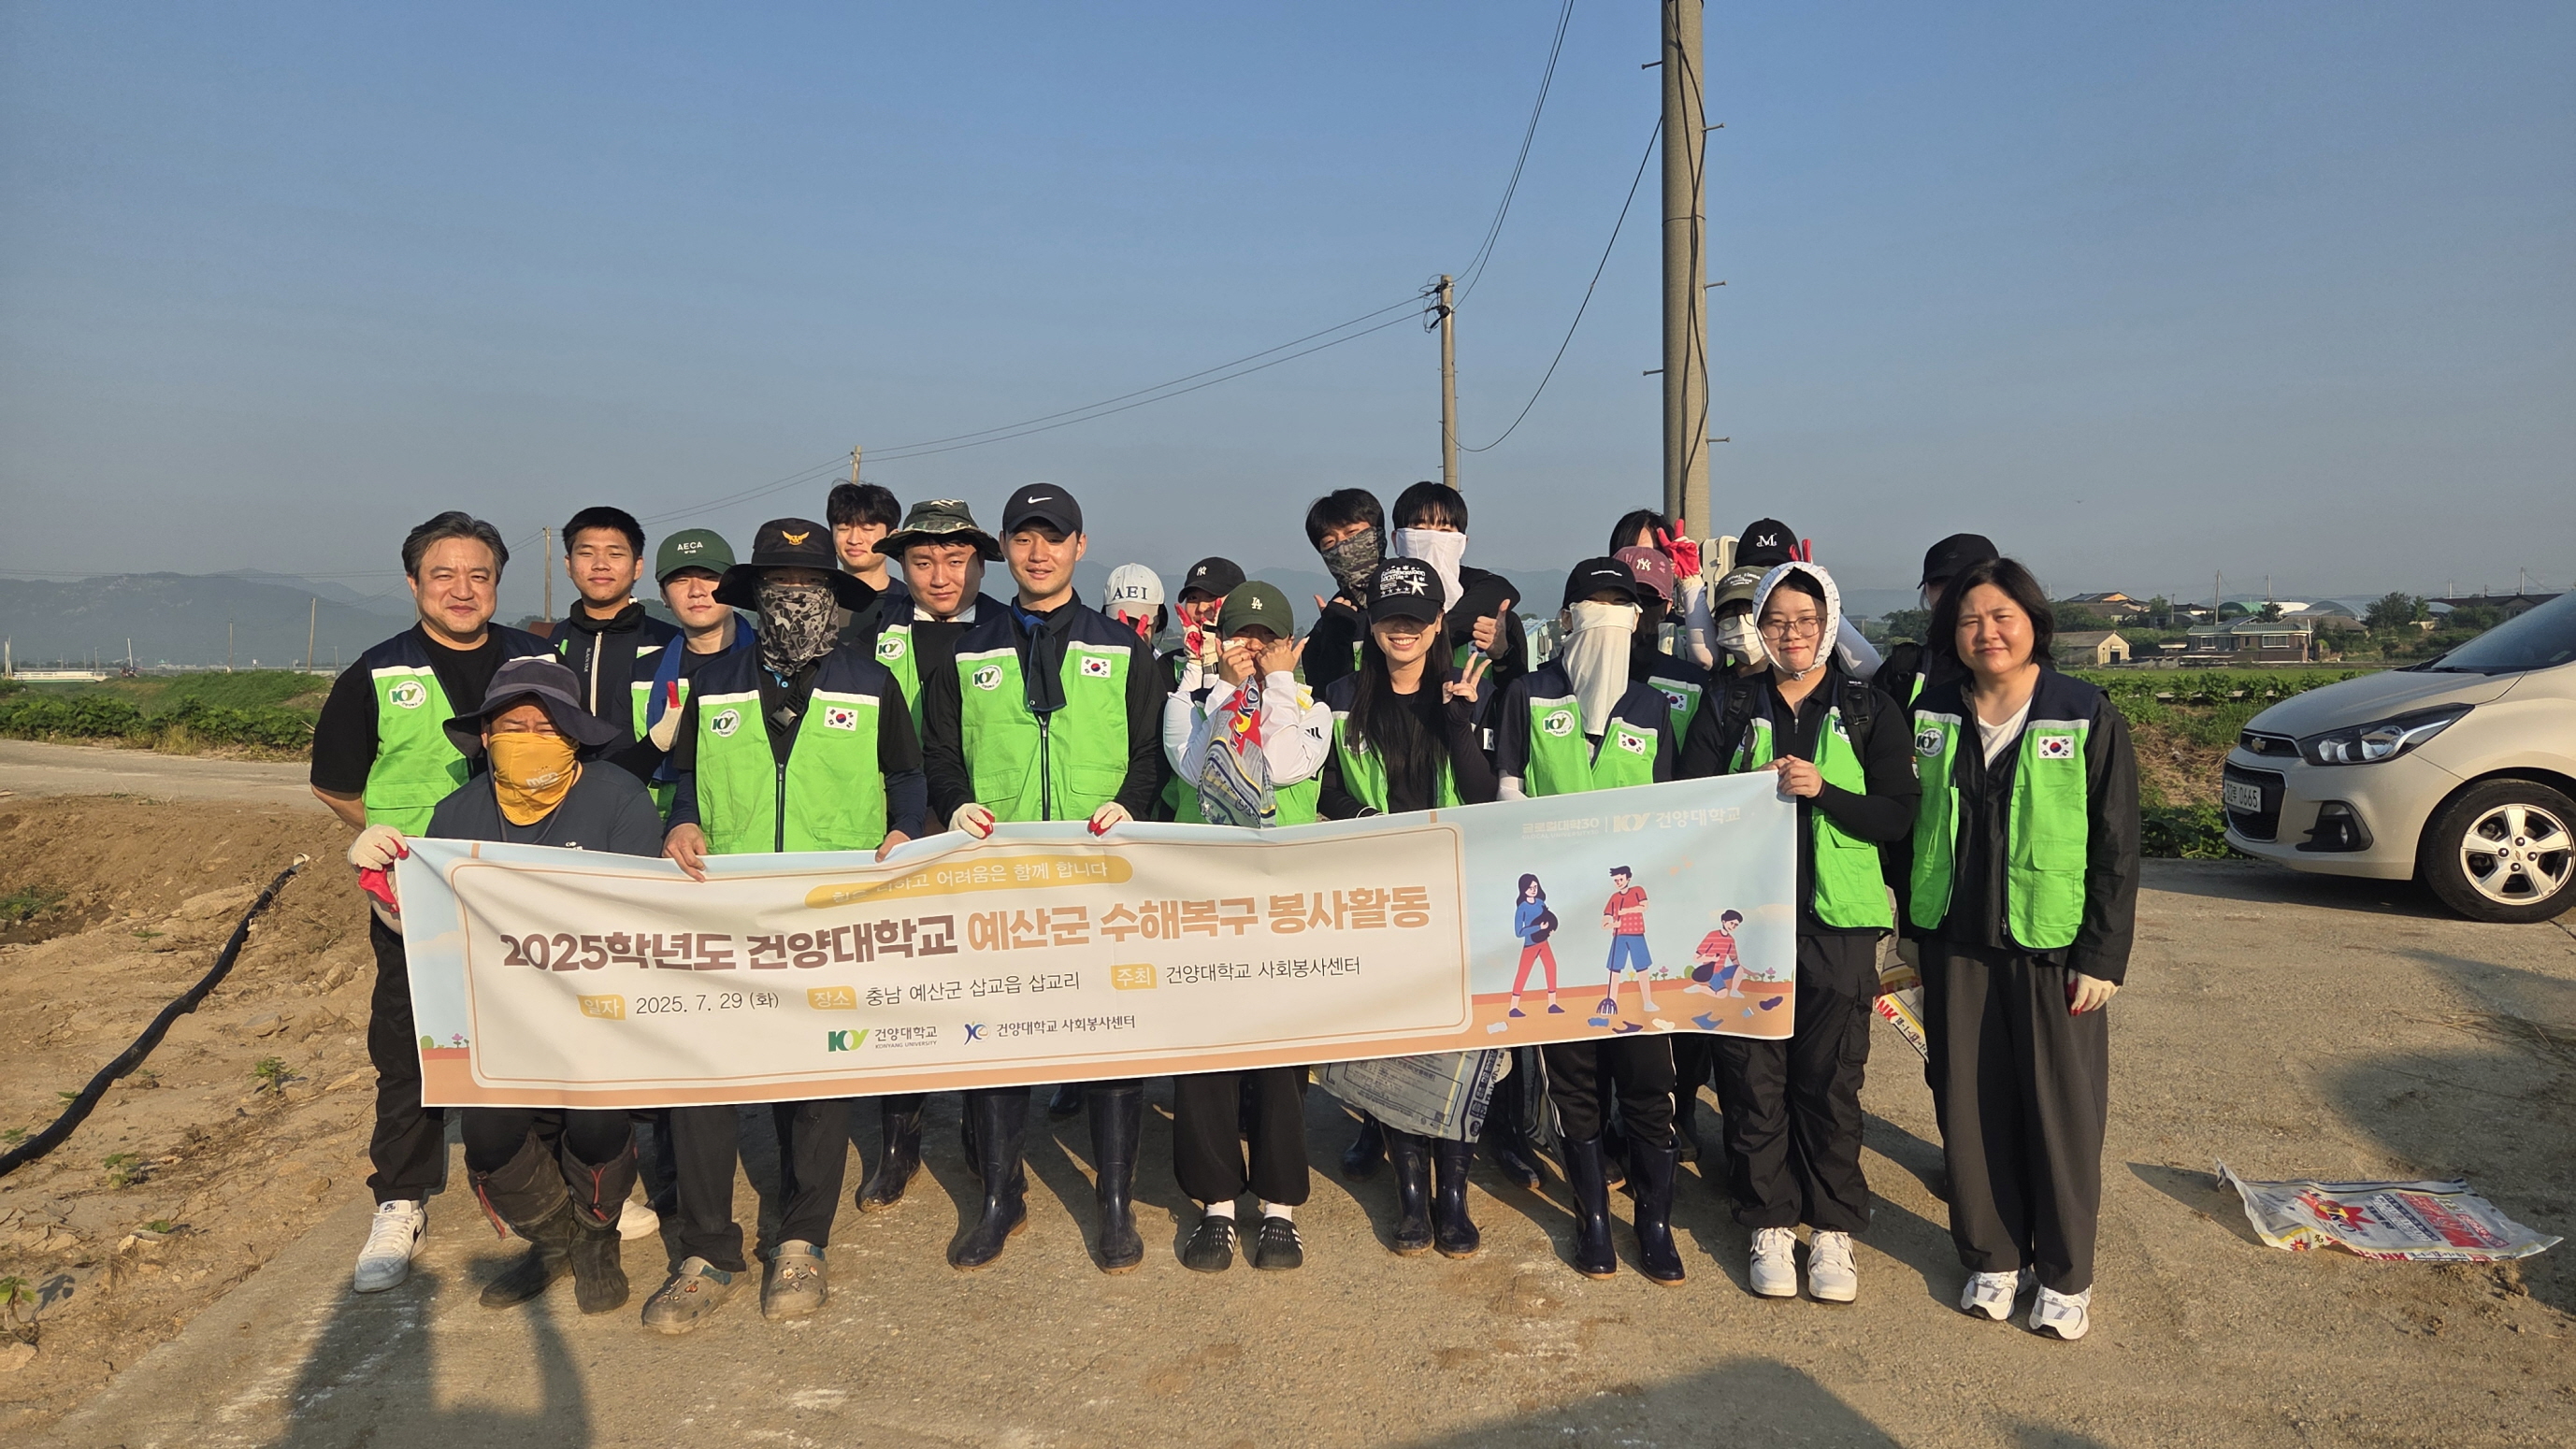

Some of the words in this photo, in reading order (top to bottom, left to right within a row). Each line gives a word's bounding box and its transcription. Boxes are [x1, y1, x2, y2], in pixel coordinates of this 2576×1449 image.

[677, 541, 703, 552] AECA
[1636, 557, 1652, 572] NY
[1112, 586, 1148, 600] AEI
[1251, 596, 1263, 610] LA
[2239, 786, 2258, 808] 0665
[1655, 807, 1741, 829] 건양대학교
[936, 864, 1007, 887] 어려움은
[1013, 862, 1049, 882] 함께
[1056, 860, 1108, 880] 합니다
[500, 930, 737, 971] 2025학년도
[747, 914, 958, 970] 건양대학교
[968, 904, 1090, 952] 예산군
[1101, 897, 1259, 942] 수해복구
[1268, 885, 1431, 934] 봉사활동
[1115, 967, 1151, 987] 주최
[1165, 963, 1252, 985] 건양대학교
[1258, 955, 1361, 979] 사회봉사센터
[865, 986, 900, 1006] 충남
[909, 981, 962, 1003] 예산군
[970, 974, 1022, 997] 삽교읍
[1028, 970, 1080, 994] 삽교리
[583, 994, 621, 1017] 일자
[636, 995, 688, 1015] 2025.
[695, 994, 712, 1012] 7.
[719, 992, 743, 1011] 29
[748, 991, 780, 1011] (화)
[813, 989, 852, 1010] 장소
[874, 1026, 938, 1041] 건양대학교
[996, 1020, 1058, 1038] 건양대학교
[1061, 1015, 1136, 1032] 사회봉사센터
[827, 1028, 870, 1053] KY
